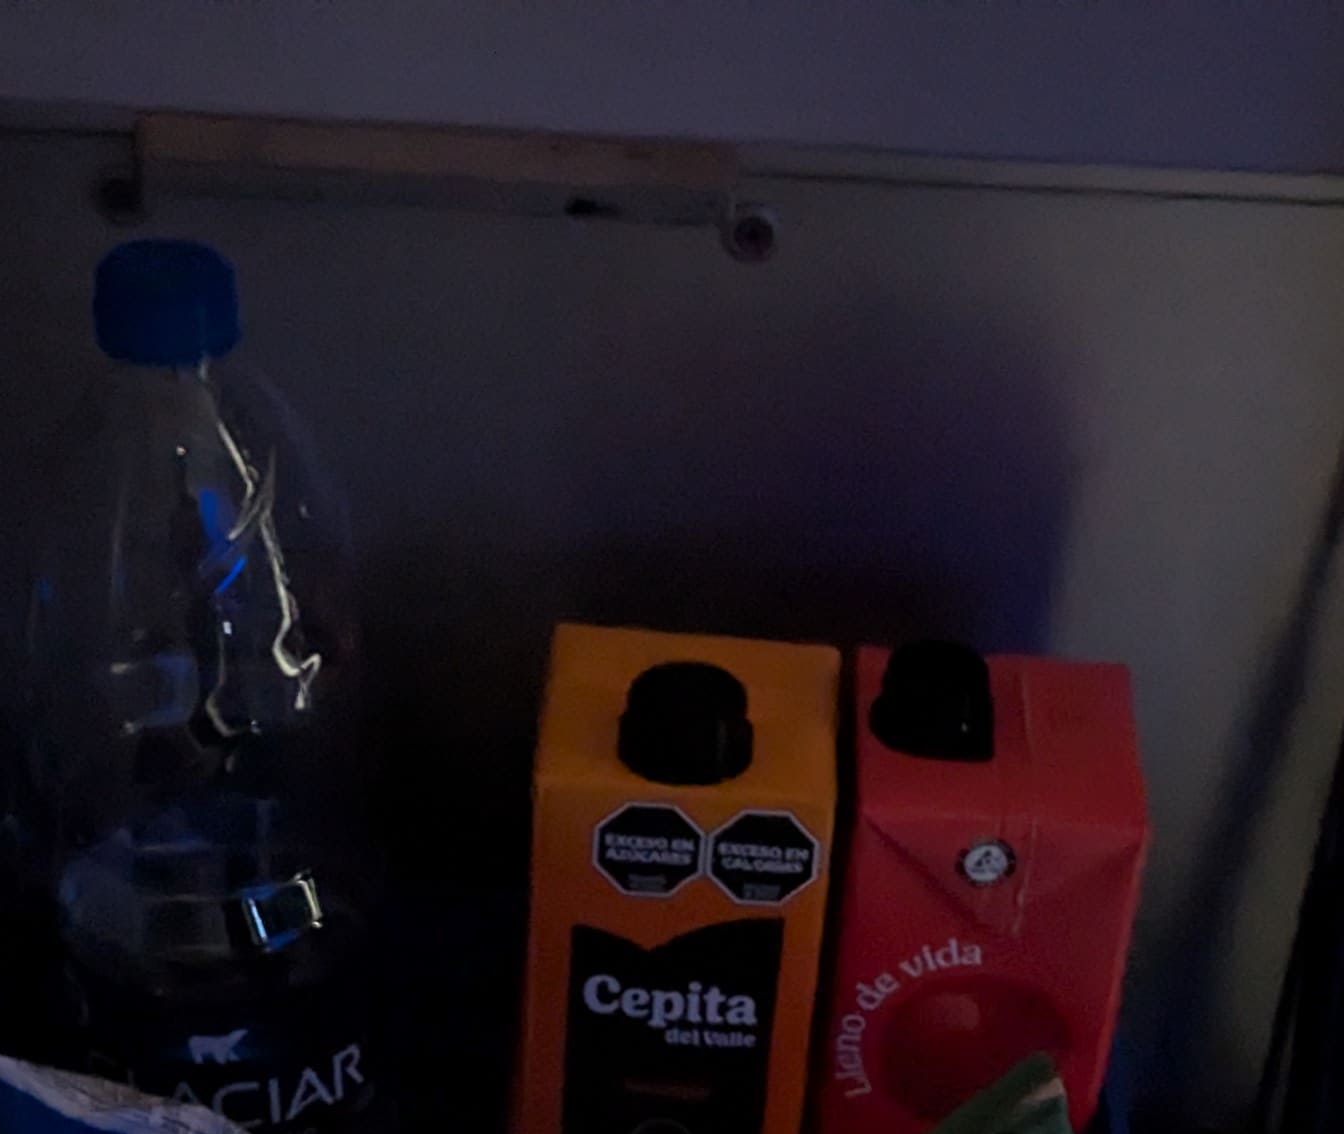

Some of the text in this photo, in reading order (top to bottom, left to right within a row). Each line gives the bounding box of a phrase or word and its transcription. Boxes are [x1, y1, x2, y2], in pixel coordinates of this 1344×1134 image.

[605, 833, 696, 852] EXCESO EN
[717, 842, 809, 862] EXCESO EN
[582, 972, 759, 1029] Cepita
[834, 1012, 873, 1099] Lleno
[855, 971, 902, 1012] de
[898, 936, 984, 978] vida
[664, 1027, 701, 1048] del
